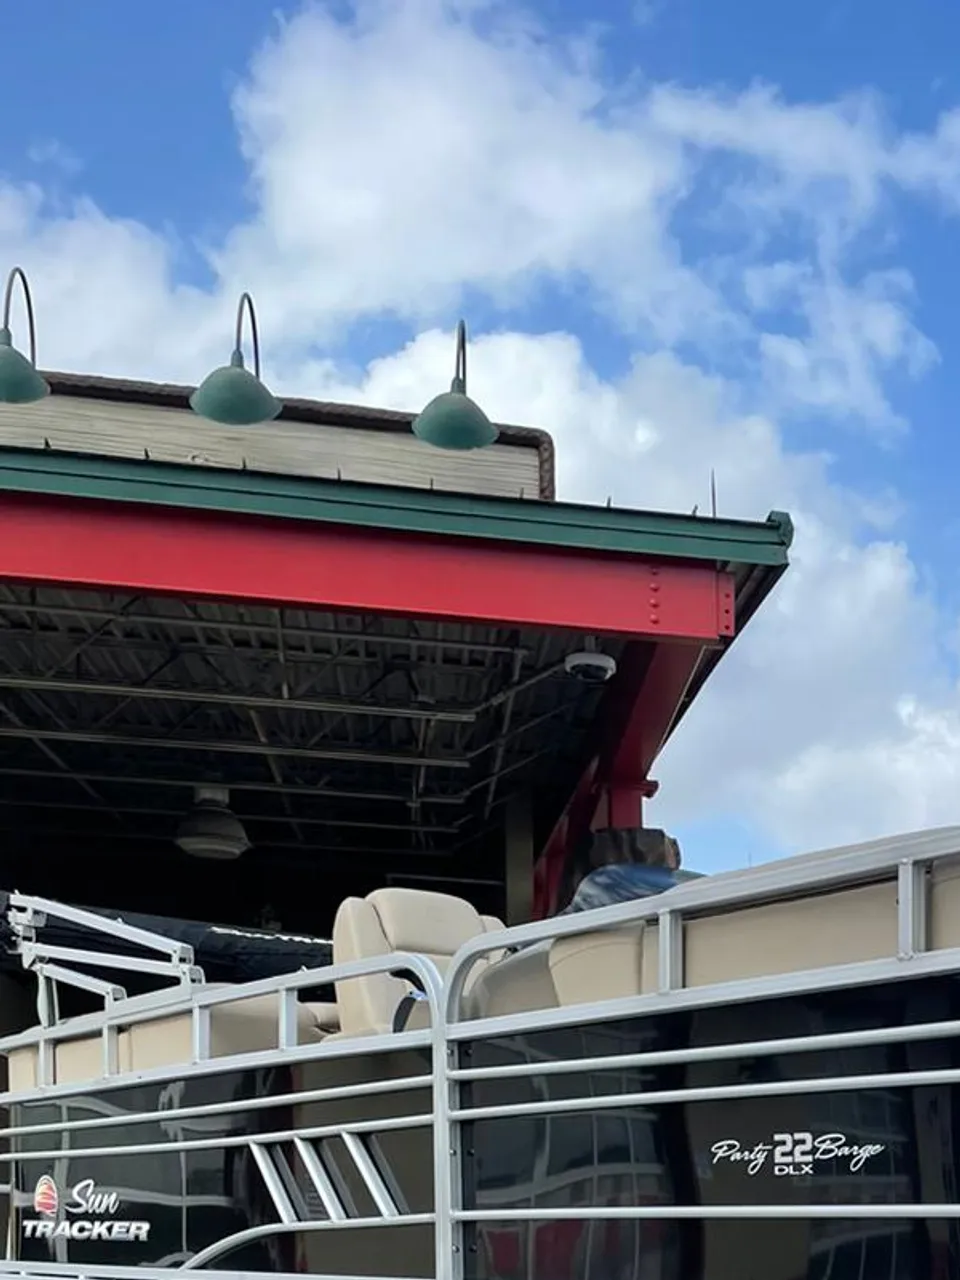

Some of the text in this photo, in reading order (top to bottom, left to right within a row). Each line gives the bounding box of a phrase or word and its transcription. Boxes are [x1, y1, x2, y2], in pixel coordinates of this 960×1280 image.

[711, 1132, 885, 1175] Party 22 Barge
[774, 1164, 814, 1176] DLX
[65, 1179, 120, 1214] Sun
[22, 1219, 151, 1242] TRACKER
